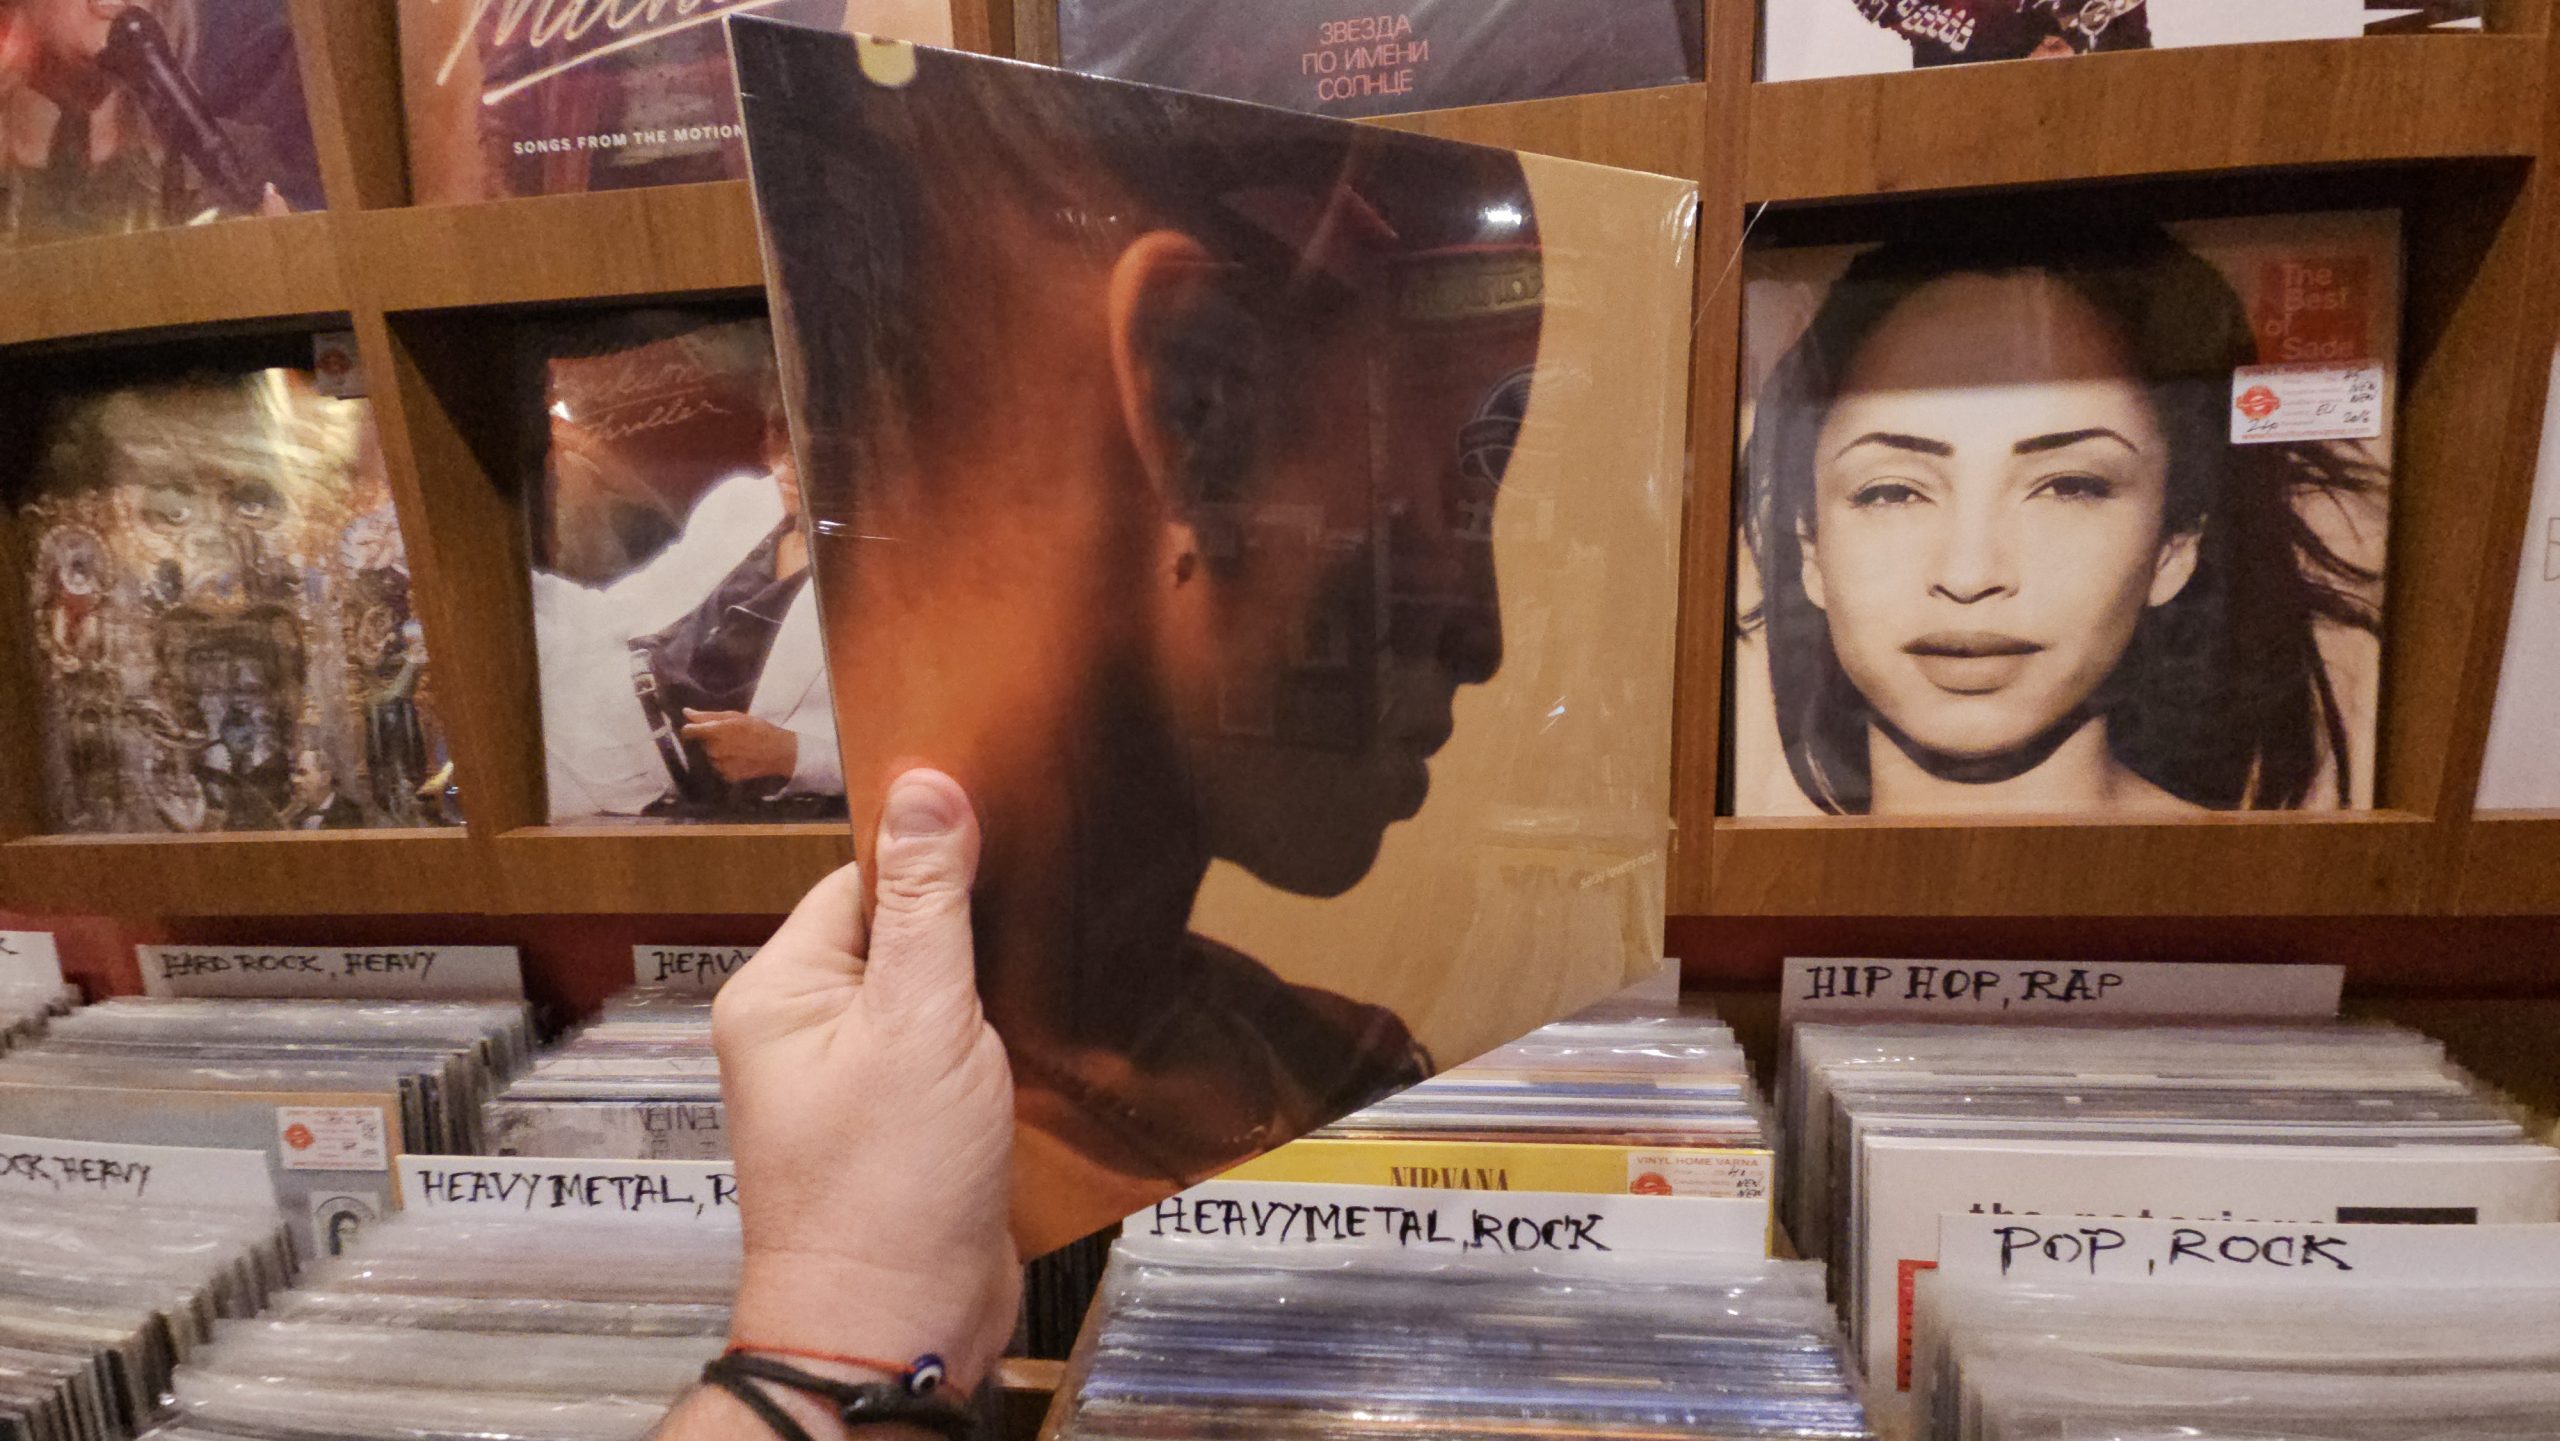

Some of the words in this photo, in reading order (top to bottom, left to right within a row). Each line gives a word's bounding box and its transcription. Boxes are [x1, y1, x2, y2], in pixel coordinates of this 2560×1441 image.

[1319, 14, 1412, 45] ЗВЕЗДА
[1302, 51, 1337, 75] ПО
[1344, 38, 1430, 71] ИМЕНИ
[1318, 69, 1414, 101] СОЛНЦЕ
[513, 138, 572, 155] SONGS
[576, 133, 628, 150] FROM
[633, 128, 667, 144] THE
[2282, 263, 2333, 287] The
[2285, 287, 2350, 311] Best
[2264, 313, 2294, 337] of
[2281, 336, 2355, 360] Sade
[1802, 966, 1893, 1000] HIP
[2019, 969, 2123, 1002] RAP
[1637, 1156, 1671, 1165] VINYL
[1675, 1156, 1712, 1166] HOME
[1716, 1157, 1760, 1167] VARNA
[1390, 1166, 1509, 1192] NIRVANA
[2169, 1228, 2353, 1271] ROCK
